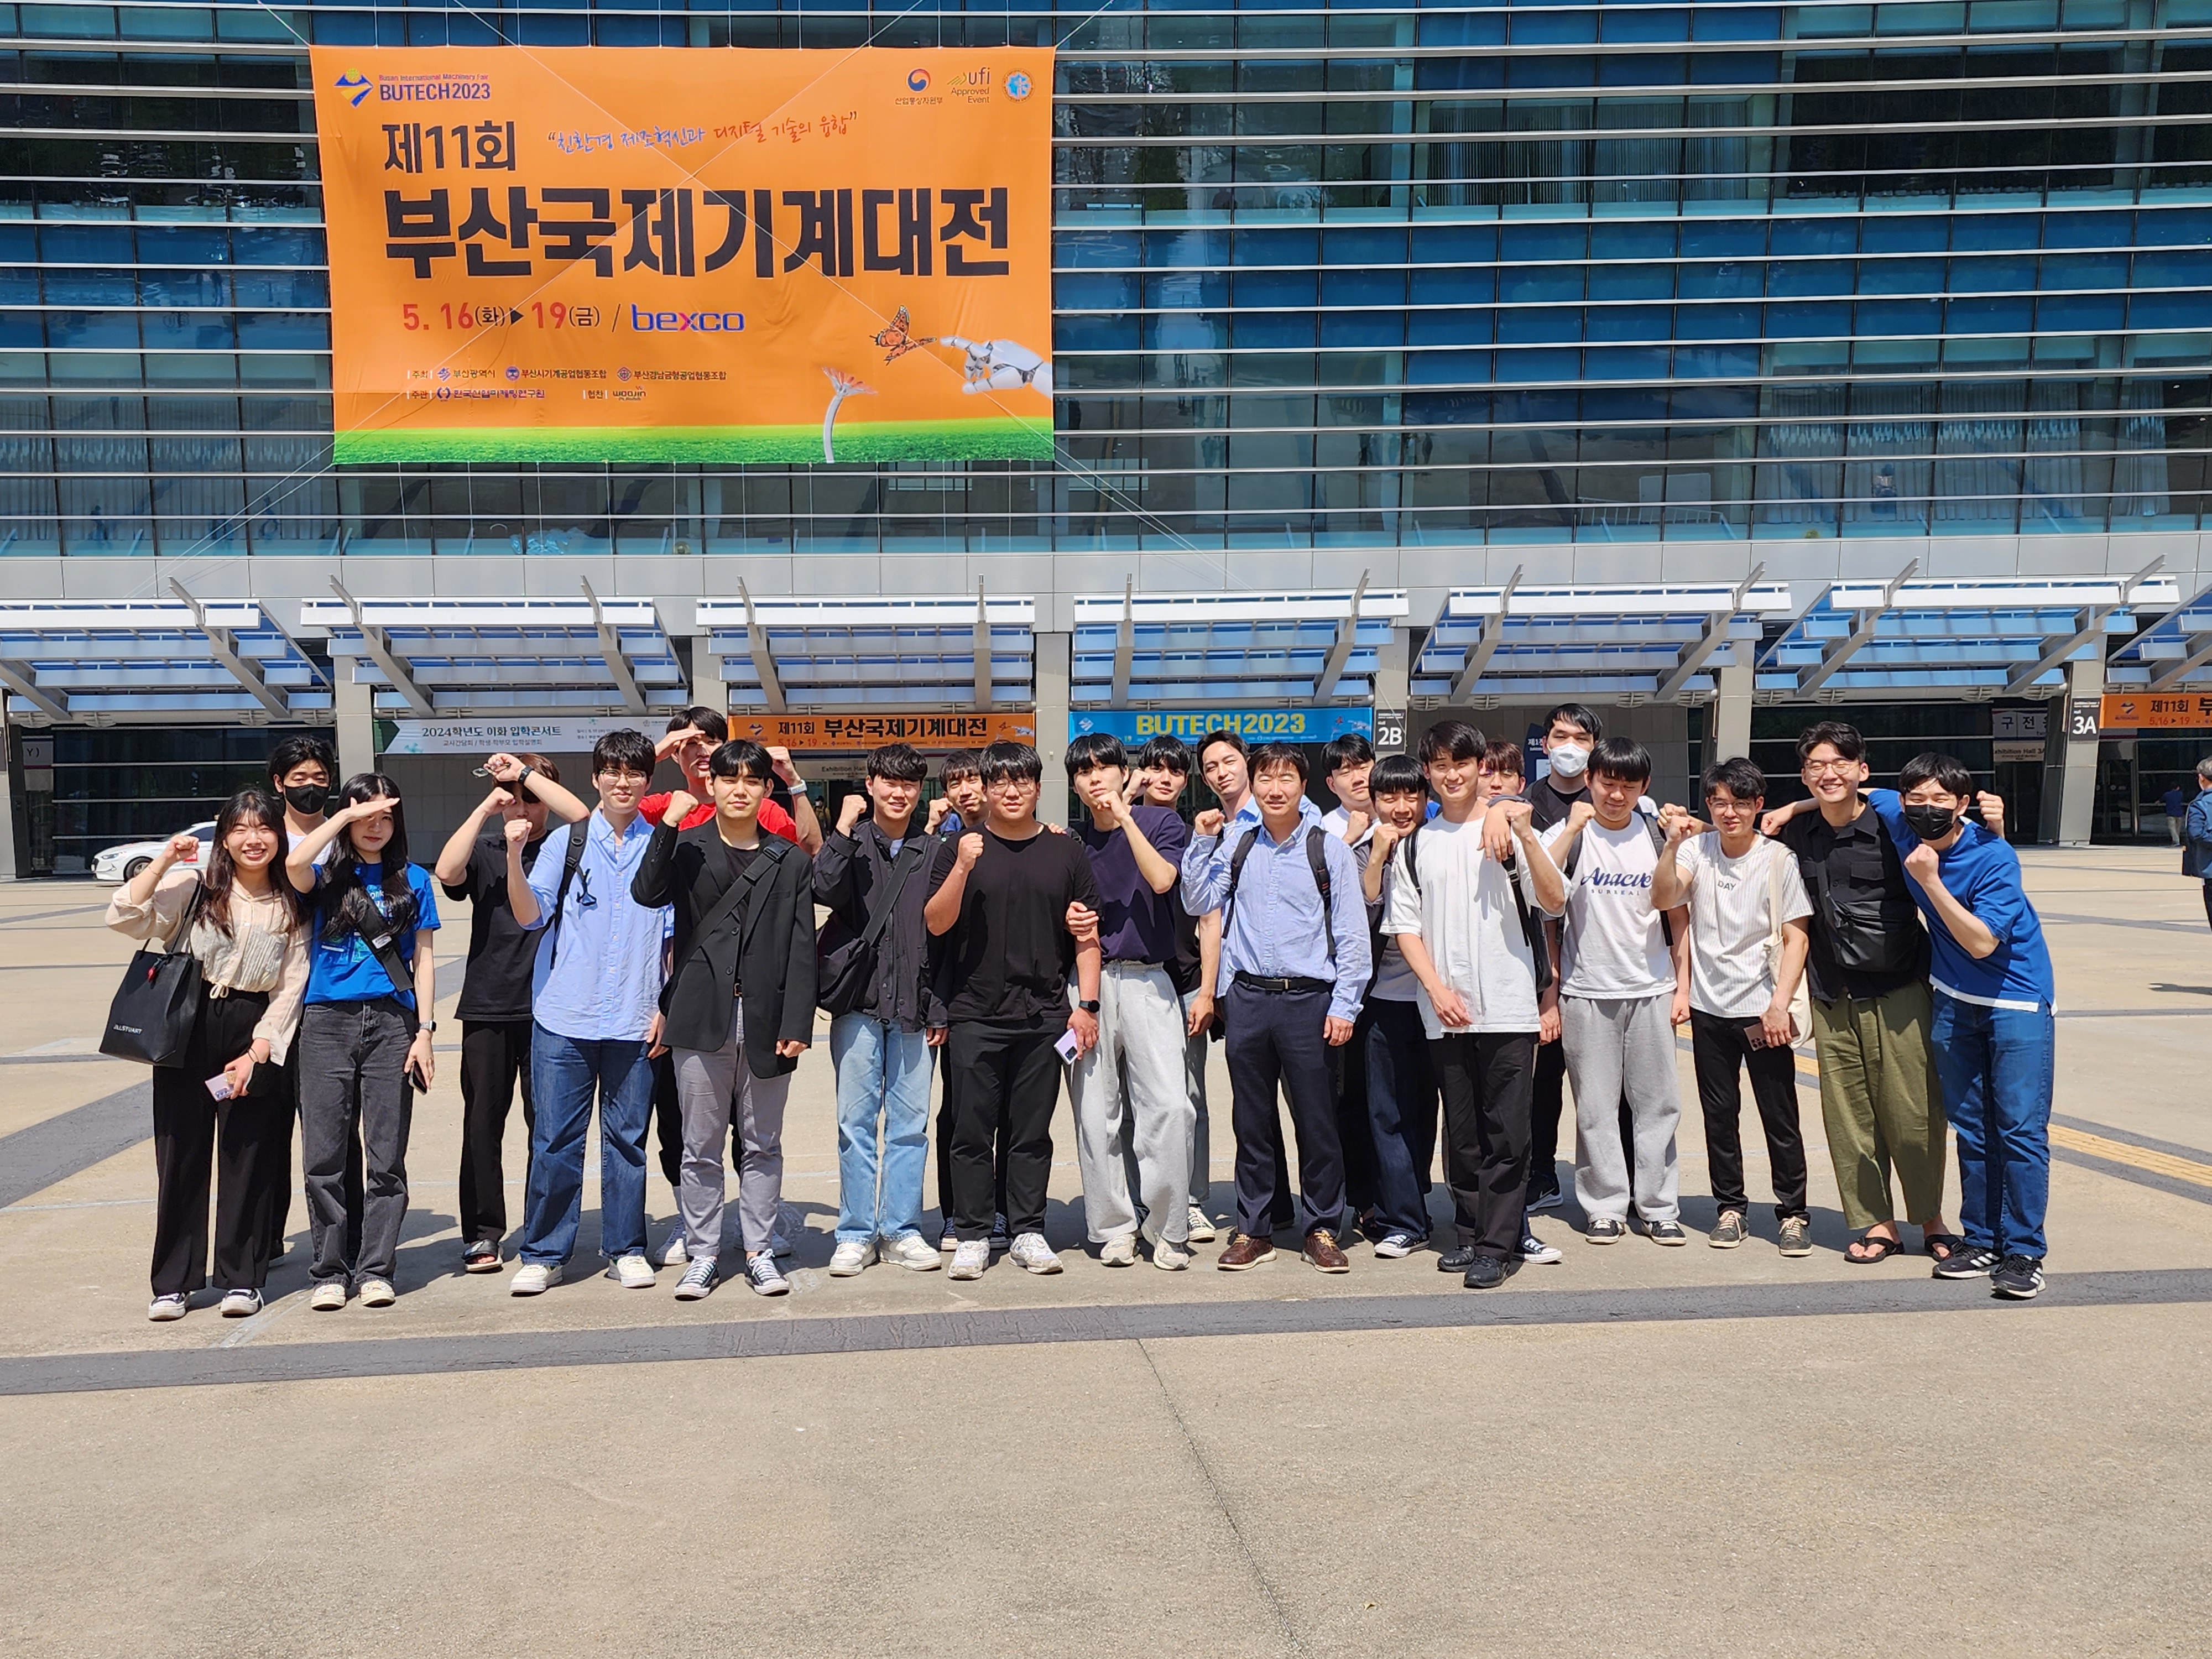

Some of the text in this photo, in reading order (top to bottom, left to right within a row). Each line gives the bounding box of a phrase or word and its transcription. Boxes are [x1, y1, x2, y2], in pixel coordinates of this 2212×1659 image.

[968, 67, 990, 85] ufi
[380, 83, 491, 101] BUTECH2023
[895, 96, 943, 105] 산업통상자원부
[620, 126, 706, 149] 제조혁신과
[713, 122, 766, 143] 디지털
[772, 117, 811, 143] 기술의
[382, 121, 516, 174] 제11회
[384, 186, 1010, 279] 부산국제기계대전
[630, 304, 745, 332] bexco
[412, 369, 727, 380] 주최 부산광역시 부산시기계공업협동조합 부산경남금형공업협동조합
[588, 390, 603, 399] 협찬
[2151, 699, 2189, 713] 제11회
[778, 718, 987, 738] 제11회 부산국제기계대전
[1136, 713, 1305, 735] BUTECH2023
[2072, 716, 2096, 734] 3A
[2150, 717, 2190, 726] 5.16 19
[422, 726, 562, 737] 2024학년도 이화 입학콘서트
[1378, 727, 1402, 745] 2B
[778, 738, 797, 747] 5.16
[808, 738, 817, 747] 19
